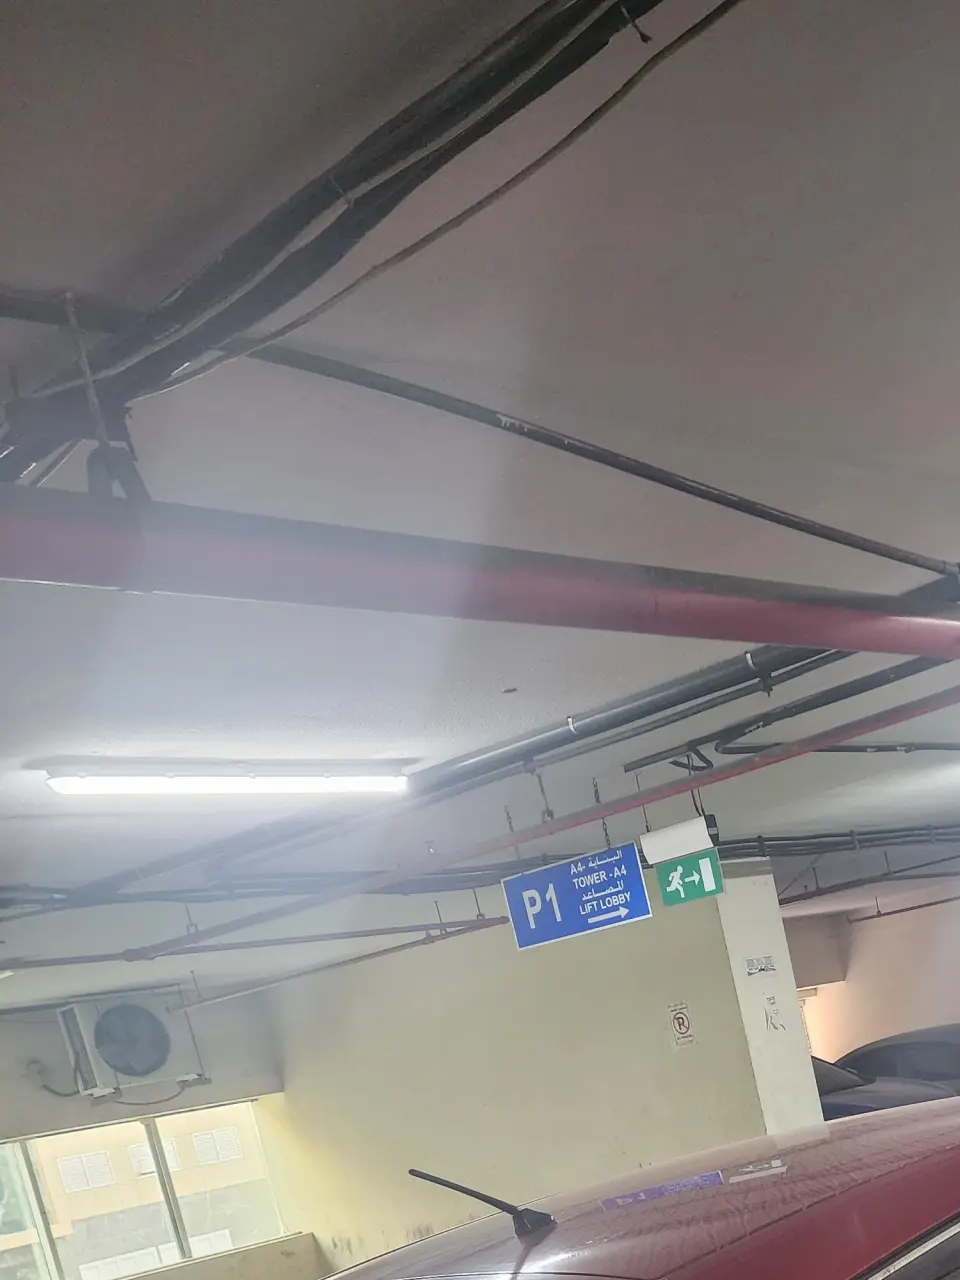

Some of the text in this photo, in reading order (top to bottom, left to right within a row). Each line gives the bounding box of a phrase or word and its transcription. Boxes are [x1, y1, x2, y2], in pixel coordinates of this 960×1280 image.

[573, 871, 608, 889] TOWER
[522, 883, 562, 930] P1
[579, 891, 631, 915] LIFT LOBBY
